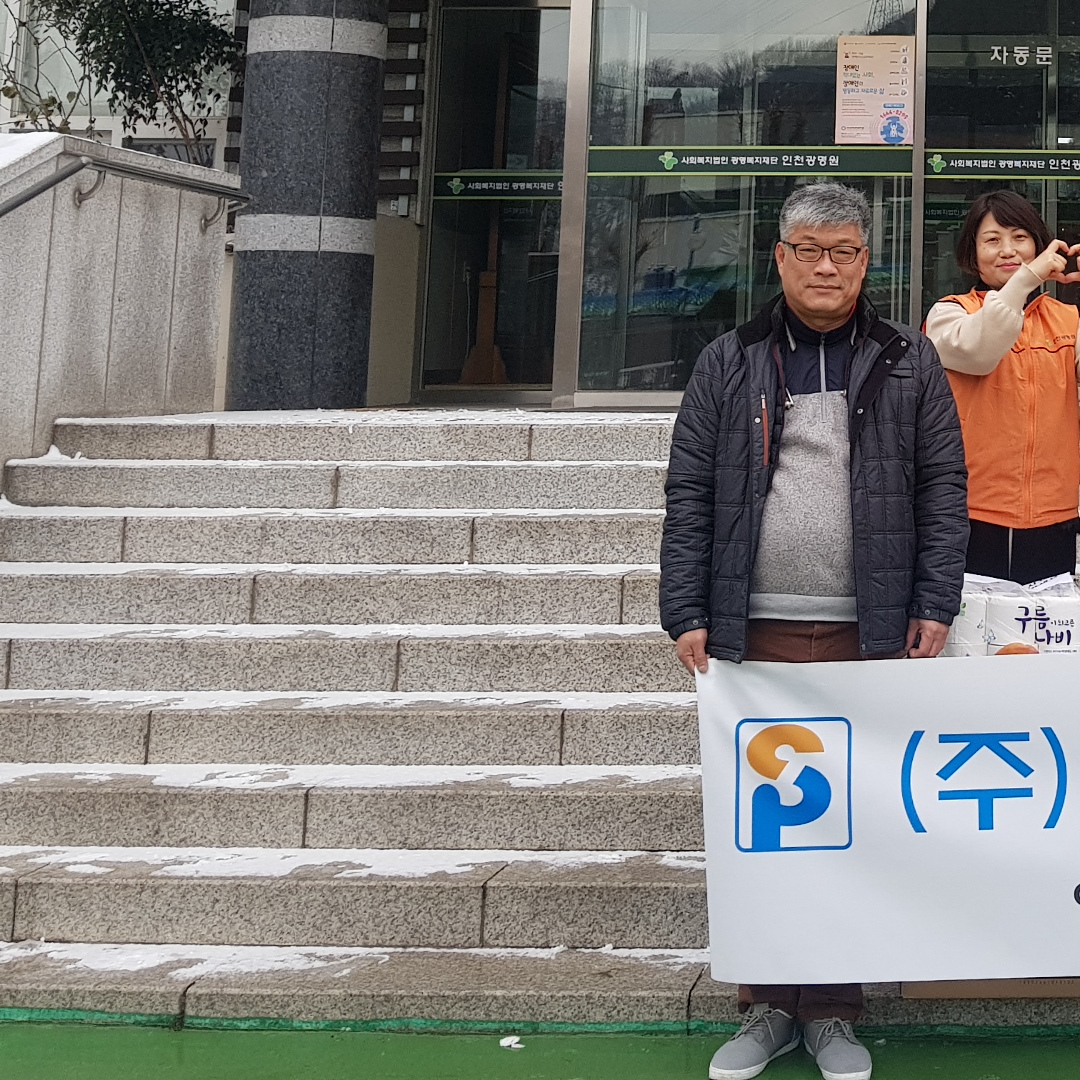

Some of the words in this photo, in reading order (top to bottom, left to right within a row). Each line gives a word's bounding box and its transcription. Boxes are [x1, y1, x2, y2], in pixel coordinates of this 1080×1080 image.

[990, 45, 1053, 66] 자동문
[680, 155, 729, 166] 사회복지법인
[730, 155, 779, 166] 광명복지재단
[781, 154, 840, 167] 인천광명원
[949, 158, 997, 169] 사회복지법인
[998, 159, 1046, 169] 광명복지재단
[1034, 629, 1072, 646] 나비
